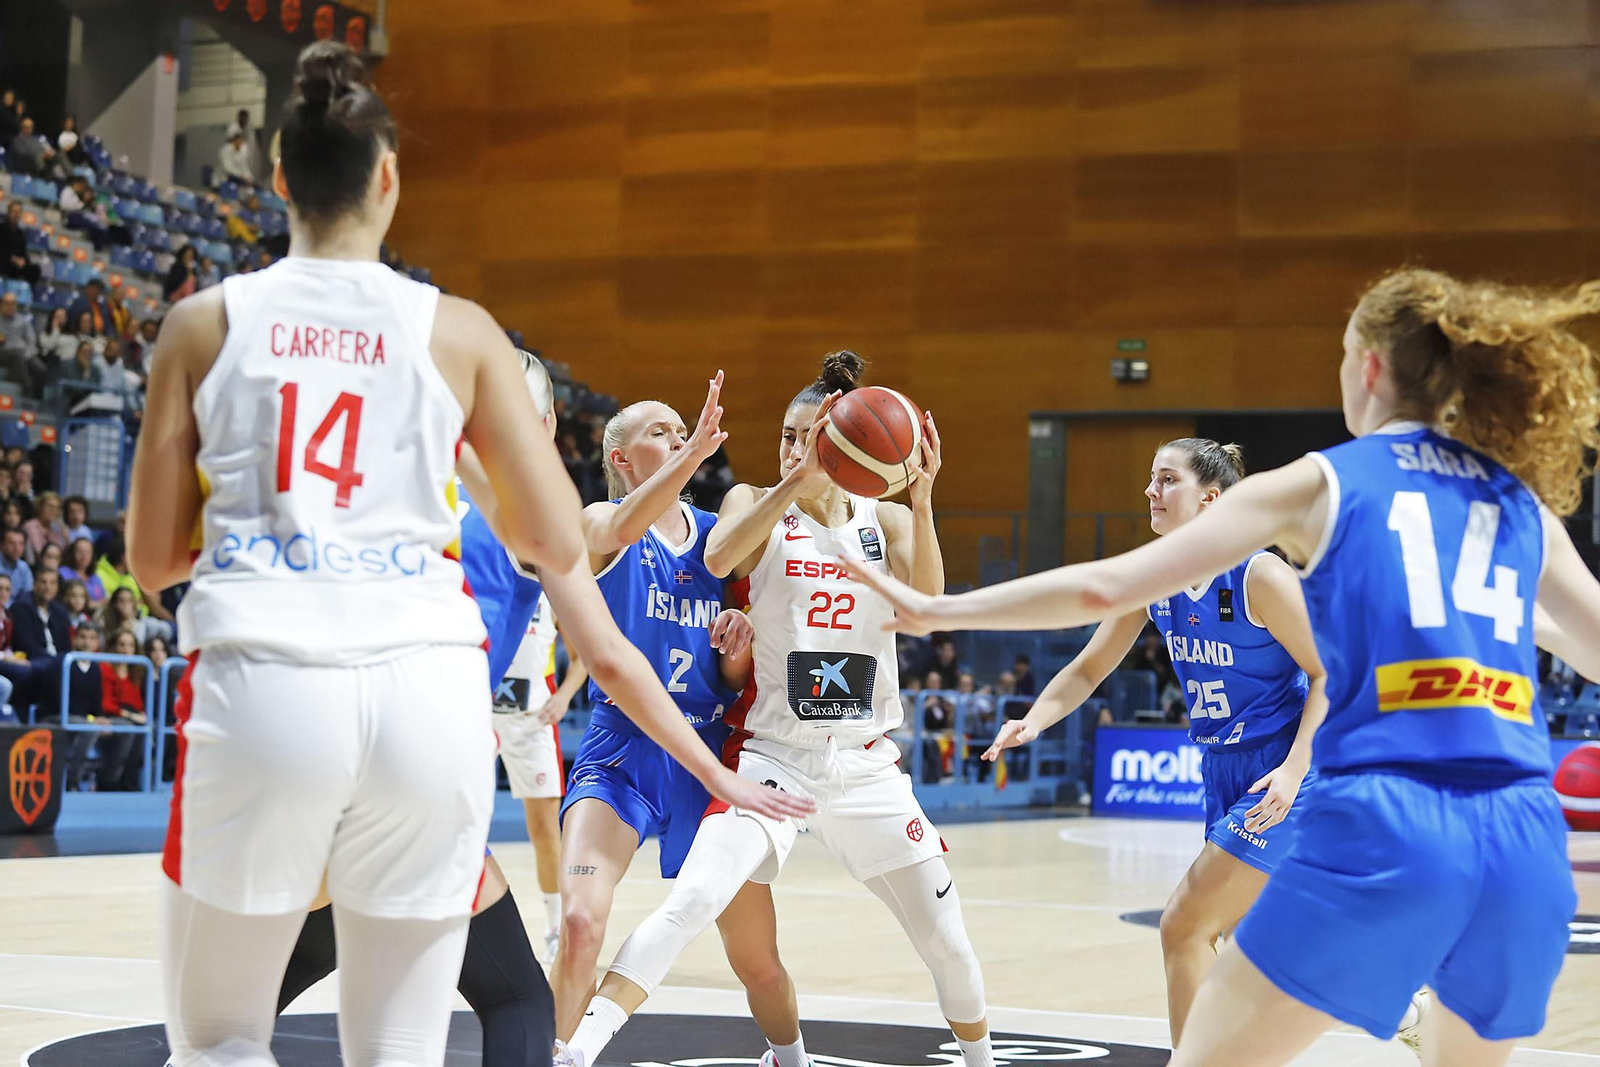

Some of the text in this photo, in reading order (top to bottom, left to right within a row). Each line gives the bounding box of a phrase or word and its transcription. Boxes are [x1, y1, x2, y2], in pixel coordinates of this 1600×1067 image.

[270, 323, 386, 365] CARRERA
[276, 382, 364, 509] 14
[1390, 441, 1491, 482] SARA
[212, 526, 427, 576] endesa
[784, 559, 850, 580] ESPA
[1386, 490, 1525, 645] 14
[646, 582, 721, 629] ÍSLAND
[807, 591, 856, 631] 22
[1220, 606, 1232, 615] FIBA
[1165, 630, 1235, 667] ÍSLAND
[667, 648, 694, 693] 2
[1408, 667, 1513, 712] DHL
[799, 701, 863, 717] CaixaBank
[1186, 679, 1231, 720] 25
[1110, 745, 1203, 785] molt
[1104, 783, 1136, 804] For
[1135, 783, 1166, 804] the
[1226, 820, 1269, 850] Kristall
[567, 865, 598, 876] 1997
